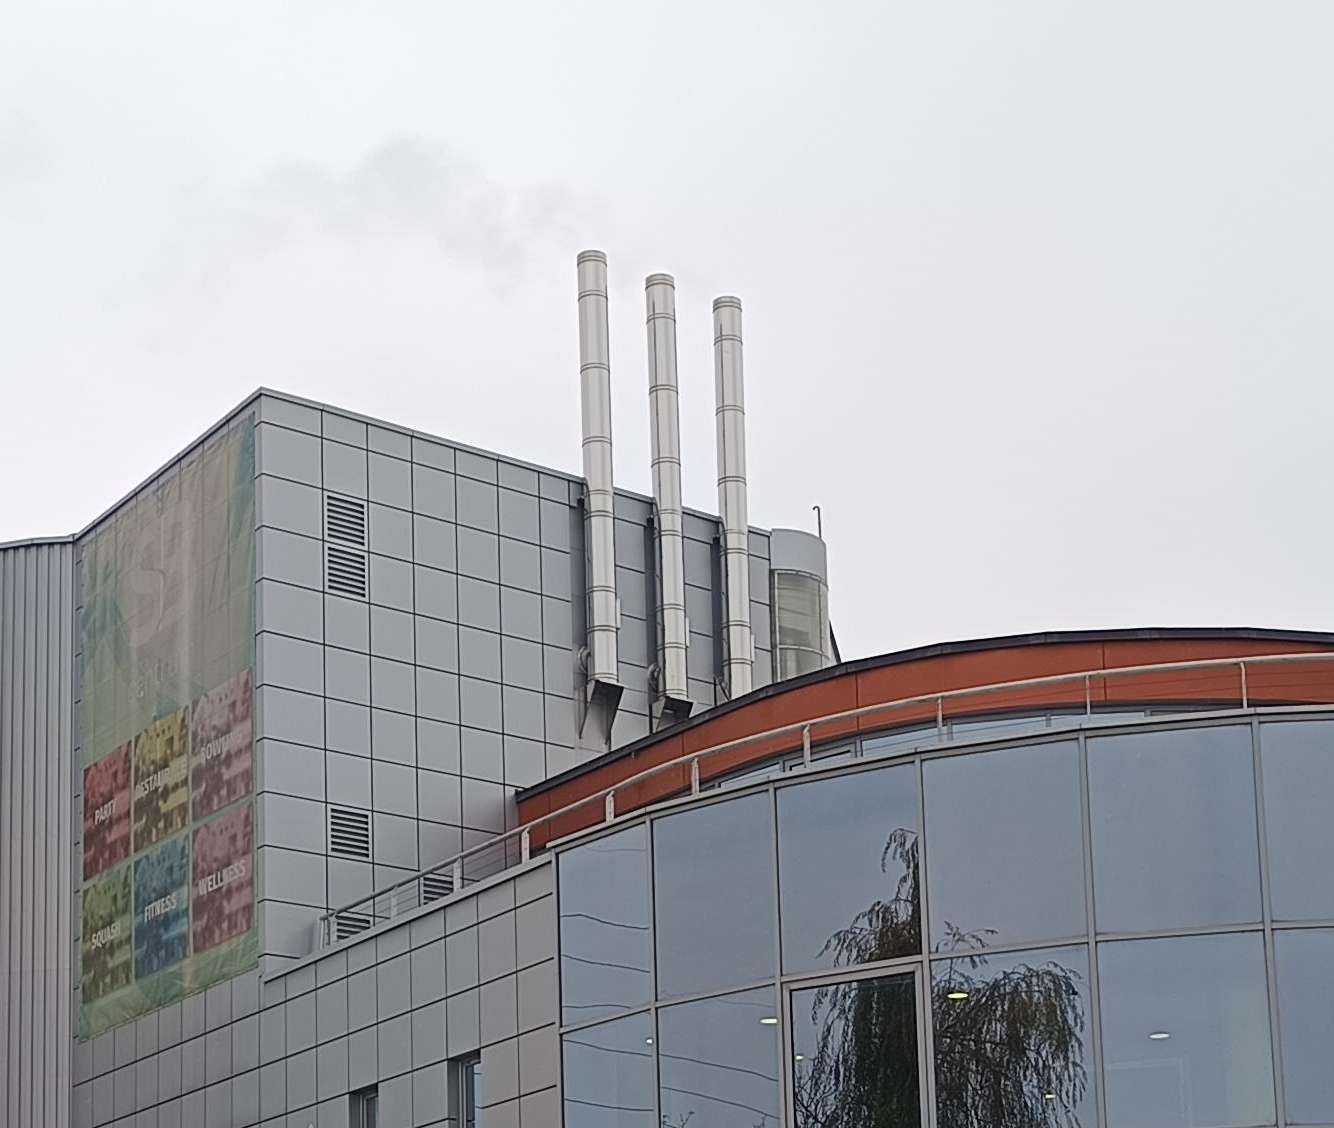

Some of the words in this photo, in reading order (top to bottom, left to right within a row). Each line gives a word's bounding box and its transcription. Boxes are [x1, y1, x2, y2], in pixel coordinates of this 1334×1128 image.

[95, 799, 117, 825] PARTY
[198, 860, 247, 896] WELLNESS
[144, 895, 177, 923] FITNESS
[92, 921, 121, 950] SQUASH
